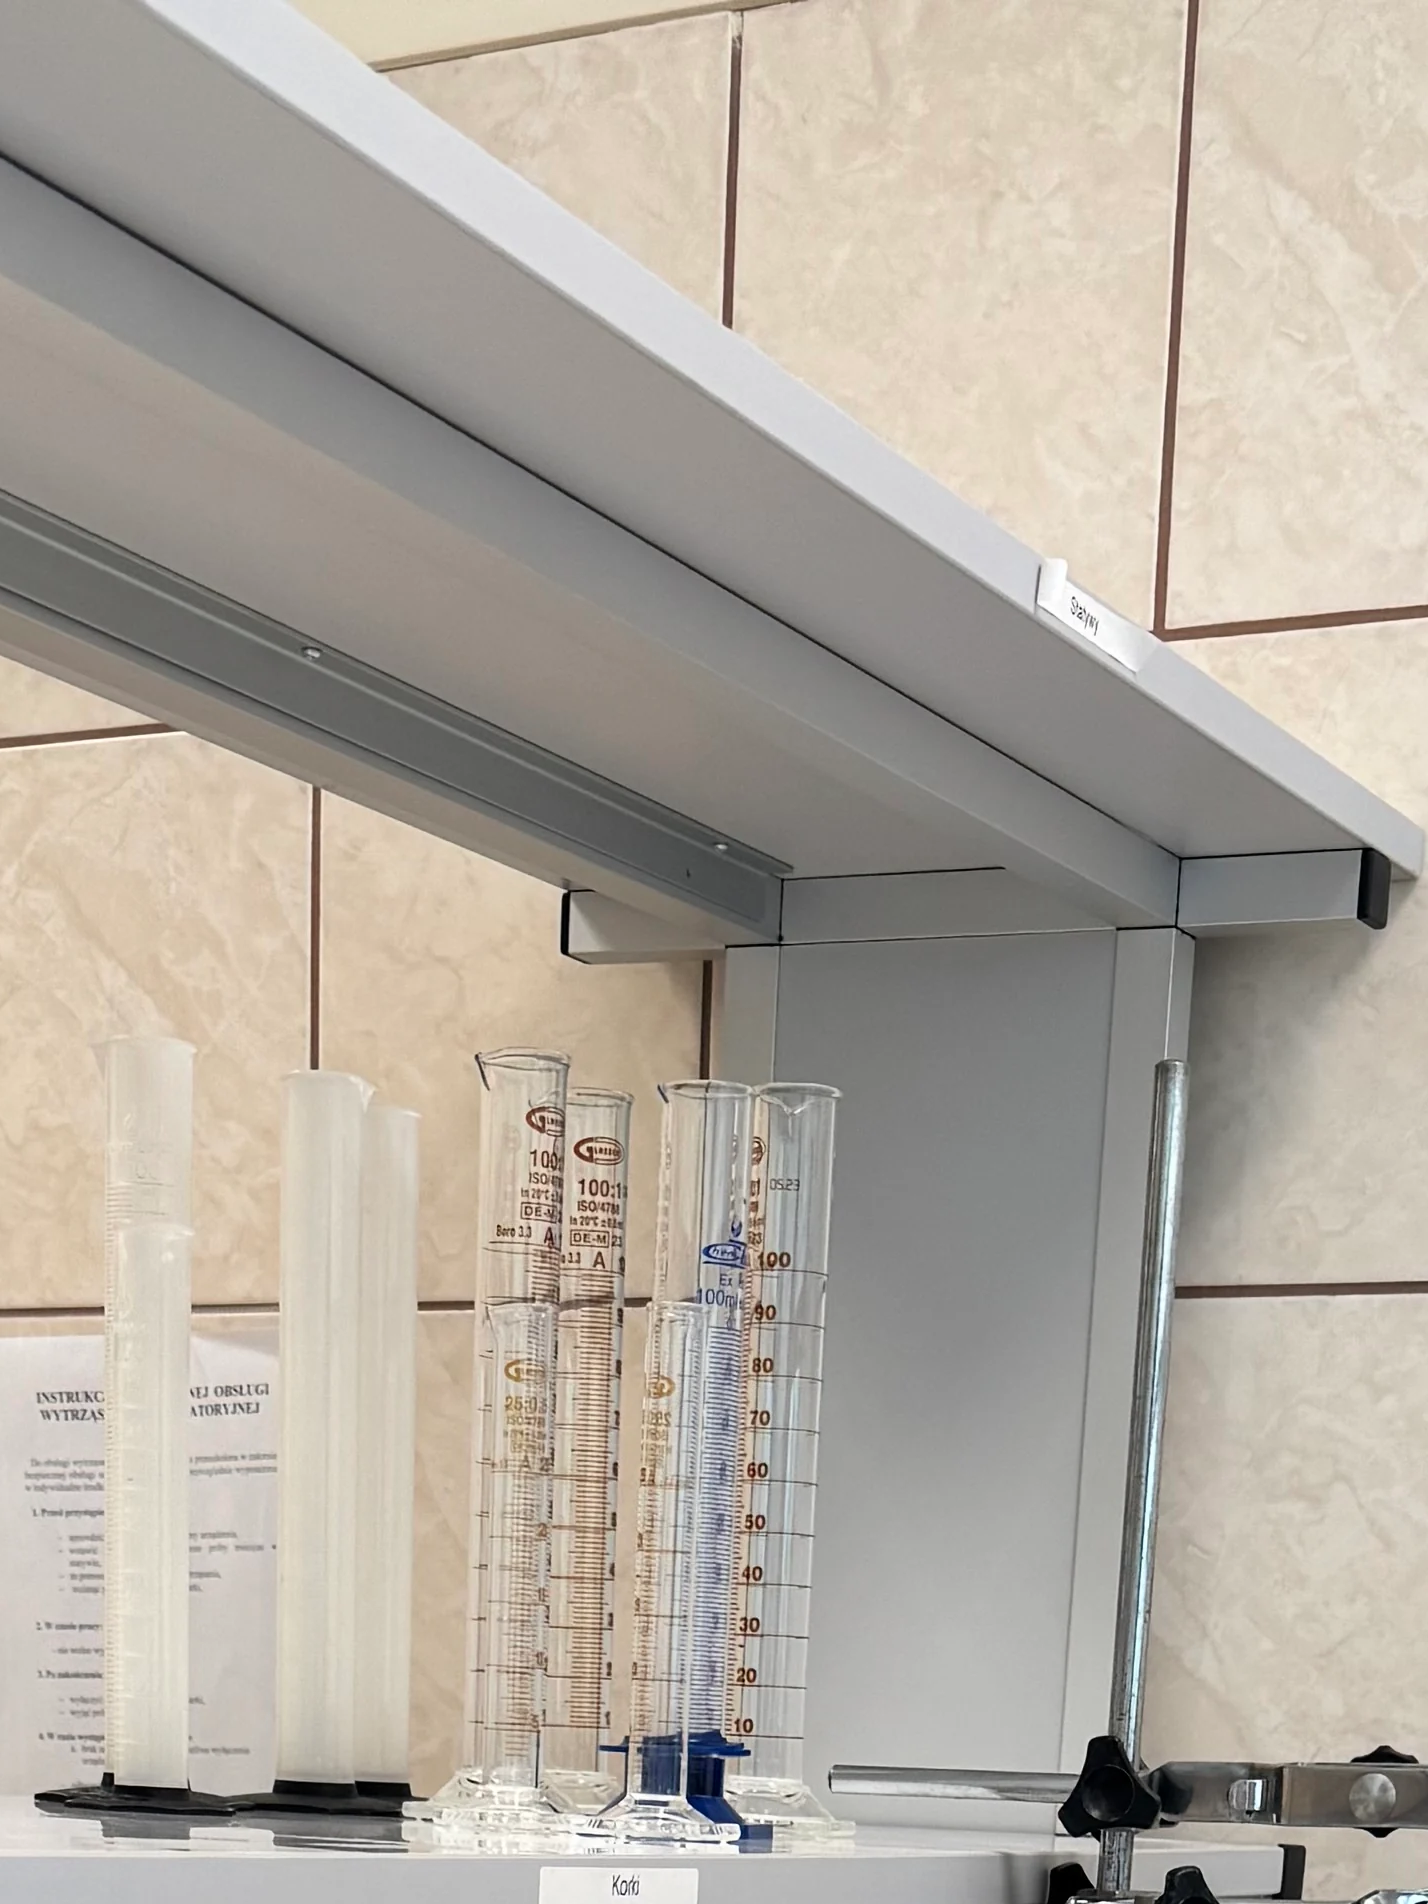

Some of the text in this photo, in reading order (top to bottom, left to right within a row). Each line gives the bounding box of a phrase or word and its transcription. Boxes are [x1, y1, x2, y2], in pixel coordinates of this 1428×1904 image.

[757, 1251, 792, 1268] 100
[753, 1304, 777, 1320] 90
[751, 1357, 774, 1374] 80
[39, 1402, 261, 1425] WYTRZĄS ATORYJNEJ
[749, 1410, 771, 1426] 70
[747, 1462, 769, 1479] 60
[744, 1514, 766, 1530] 50
[741, 1565, 763, 1582] 40
[739, 1617, 760, 1633] 30
[736, 1667, 757, 1683] 20
[734, 1718, 754, 1734] 10
